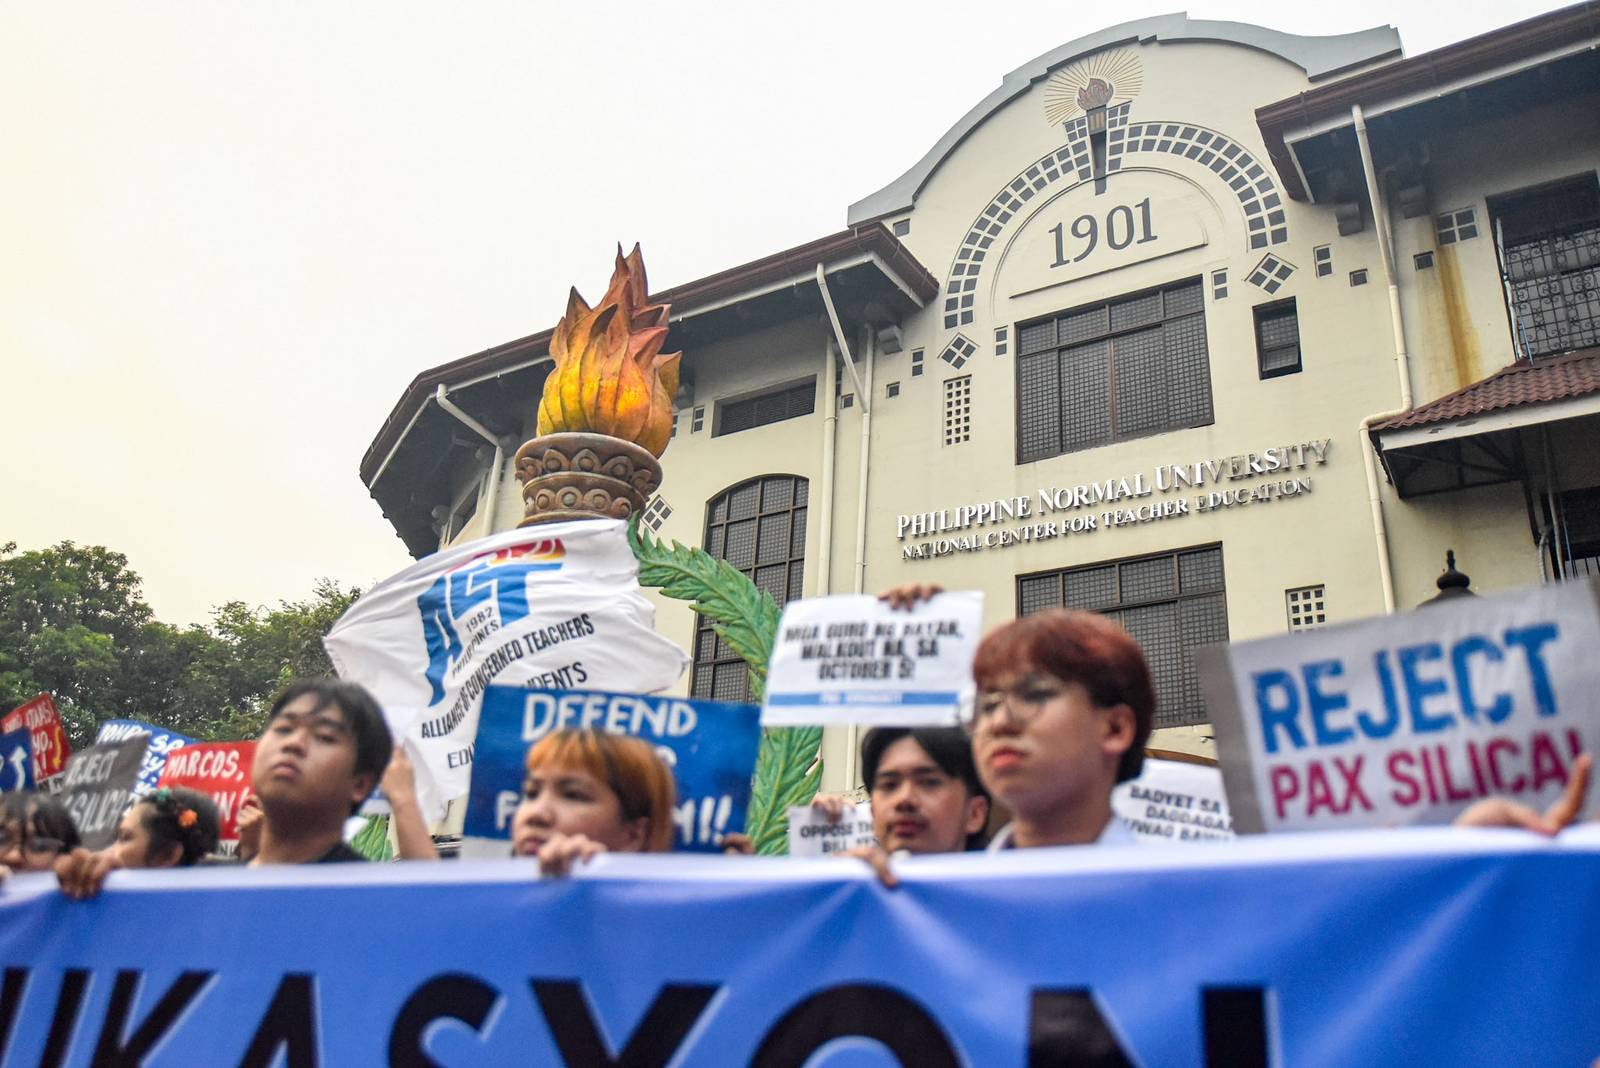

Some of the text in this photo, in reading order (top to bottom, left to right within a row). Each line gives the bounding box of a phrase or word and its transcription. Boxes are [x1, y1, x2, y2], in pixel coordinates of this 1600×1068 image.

[1048, 197, 1158, 268] 1901
[896, 438, 1331, 539] PHILIPPINE NORMAL UNIVERSITY
[903, 476, 1312, 560] NATIONAL CENTER FOR TEACHER EDUCATION
[452, 619, 499, 679] PHILIPPINES
[465, 606, 493, 633] 1982
[466, 639, 524, 701] CONCERNED
[523, 613, 595, 654] TEACHERS
[819, 661, 891, 680] OCTOBER
[1251, 623, 1558, 753] REJECT
[522, 692, 698, 742] DEFEND
[166, 750, 245, 782] MARCOS,
[1270, 756, 1372, 819] PAX
